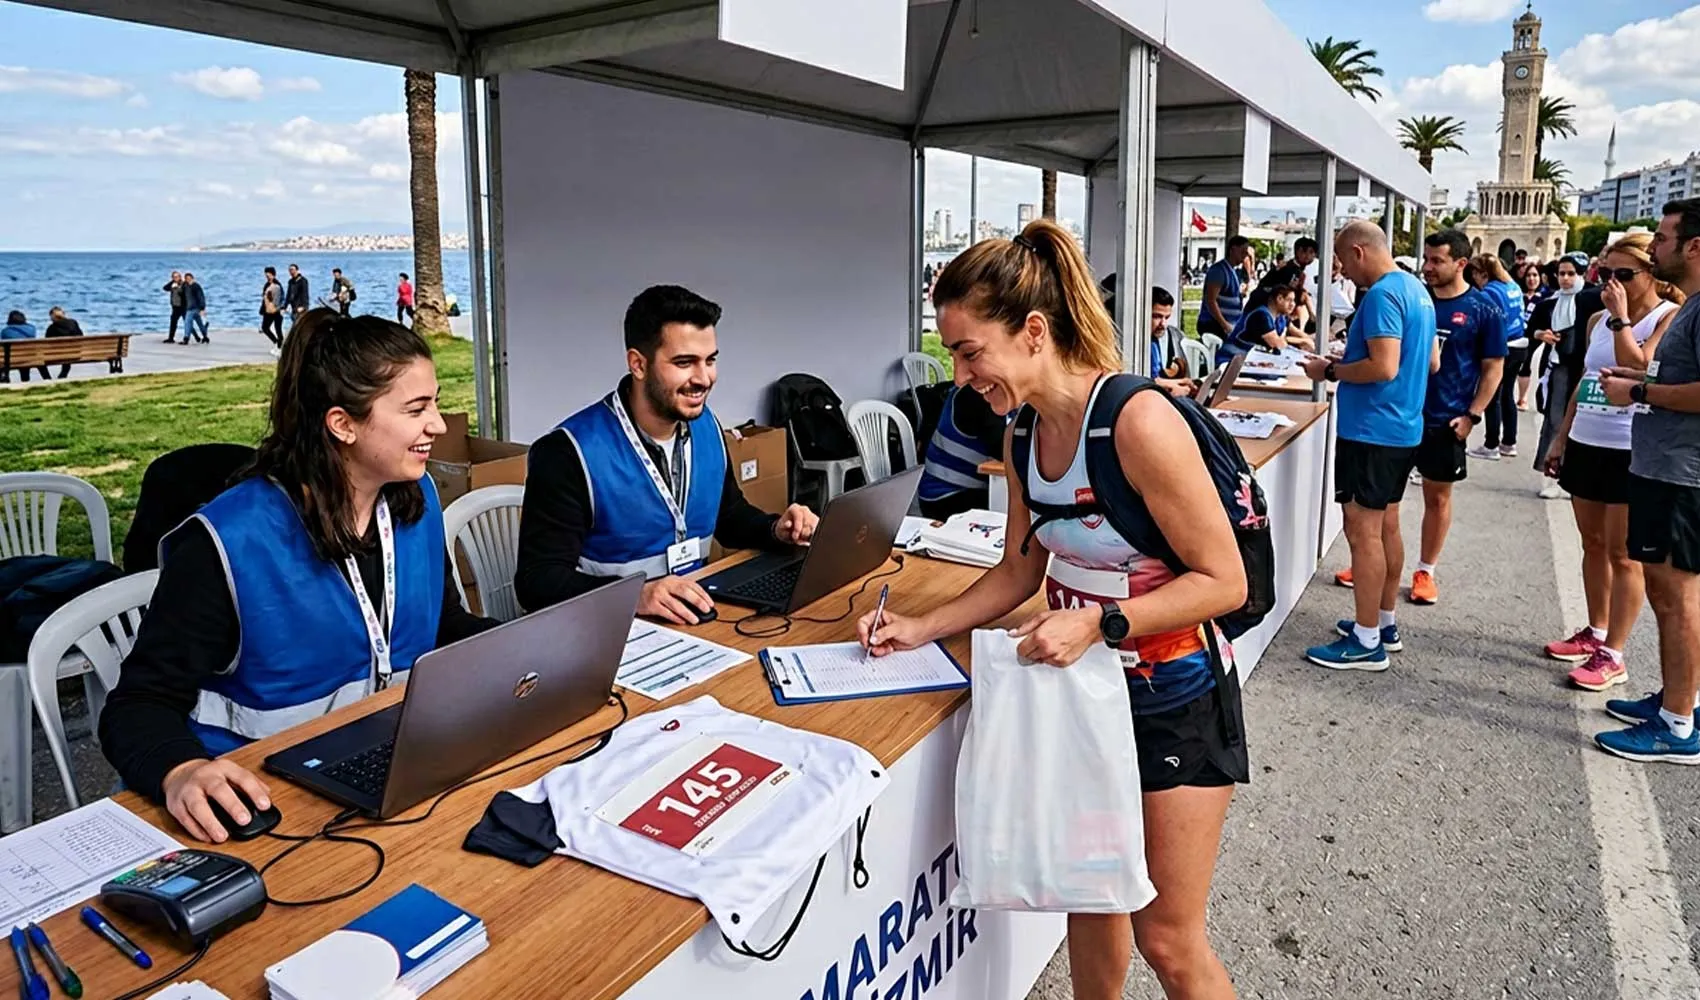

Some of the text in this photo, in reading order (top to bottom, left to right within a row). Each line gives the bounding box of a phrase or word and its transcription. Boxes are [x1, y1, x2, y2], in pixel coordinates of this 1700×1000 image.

[657, 760, 742, 818] 145
[800, 841, 960, 1000] ARAT
[871, 907, 978, 1000] ZMİR
